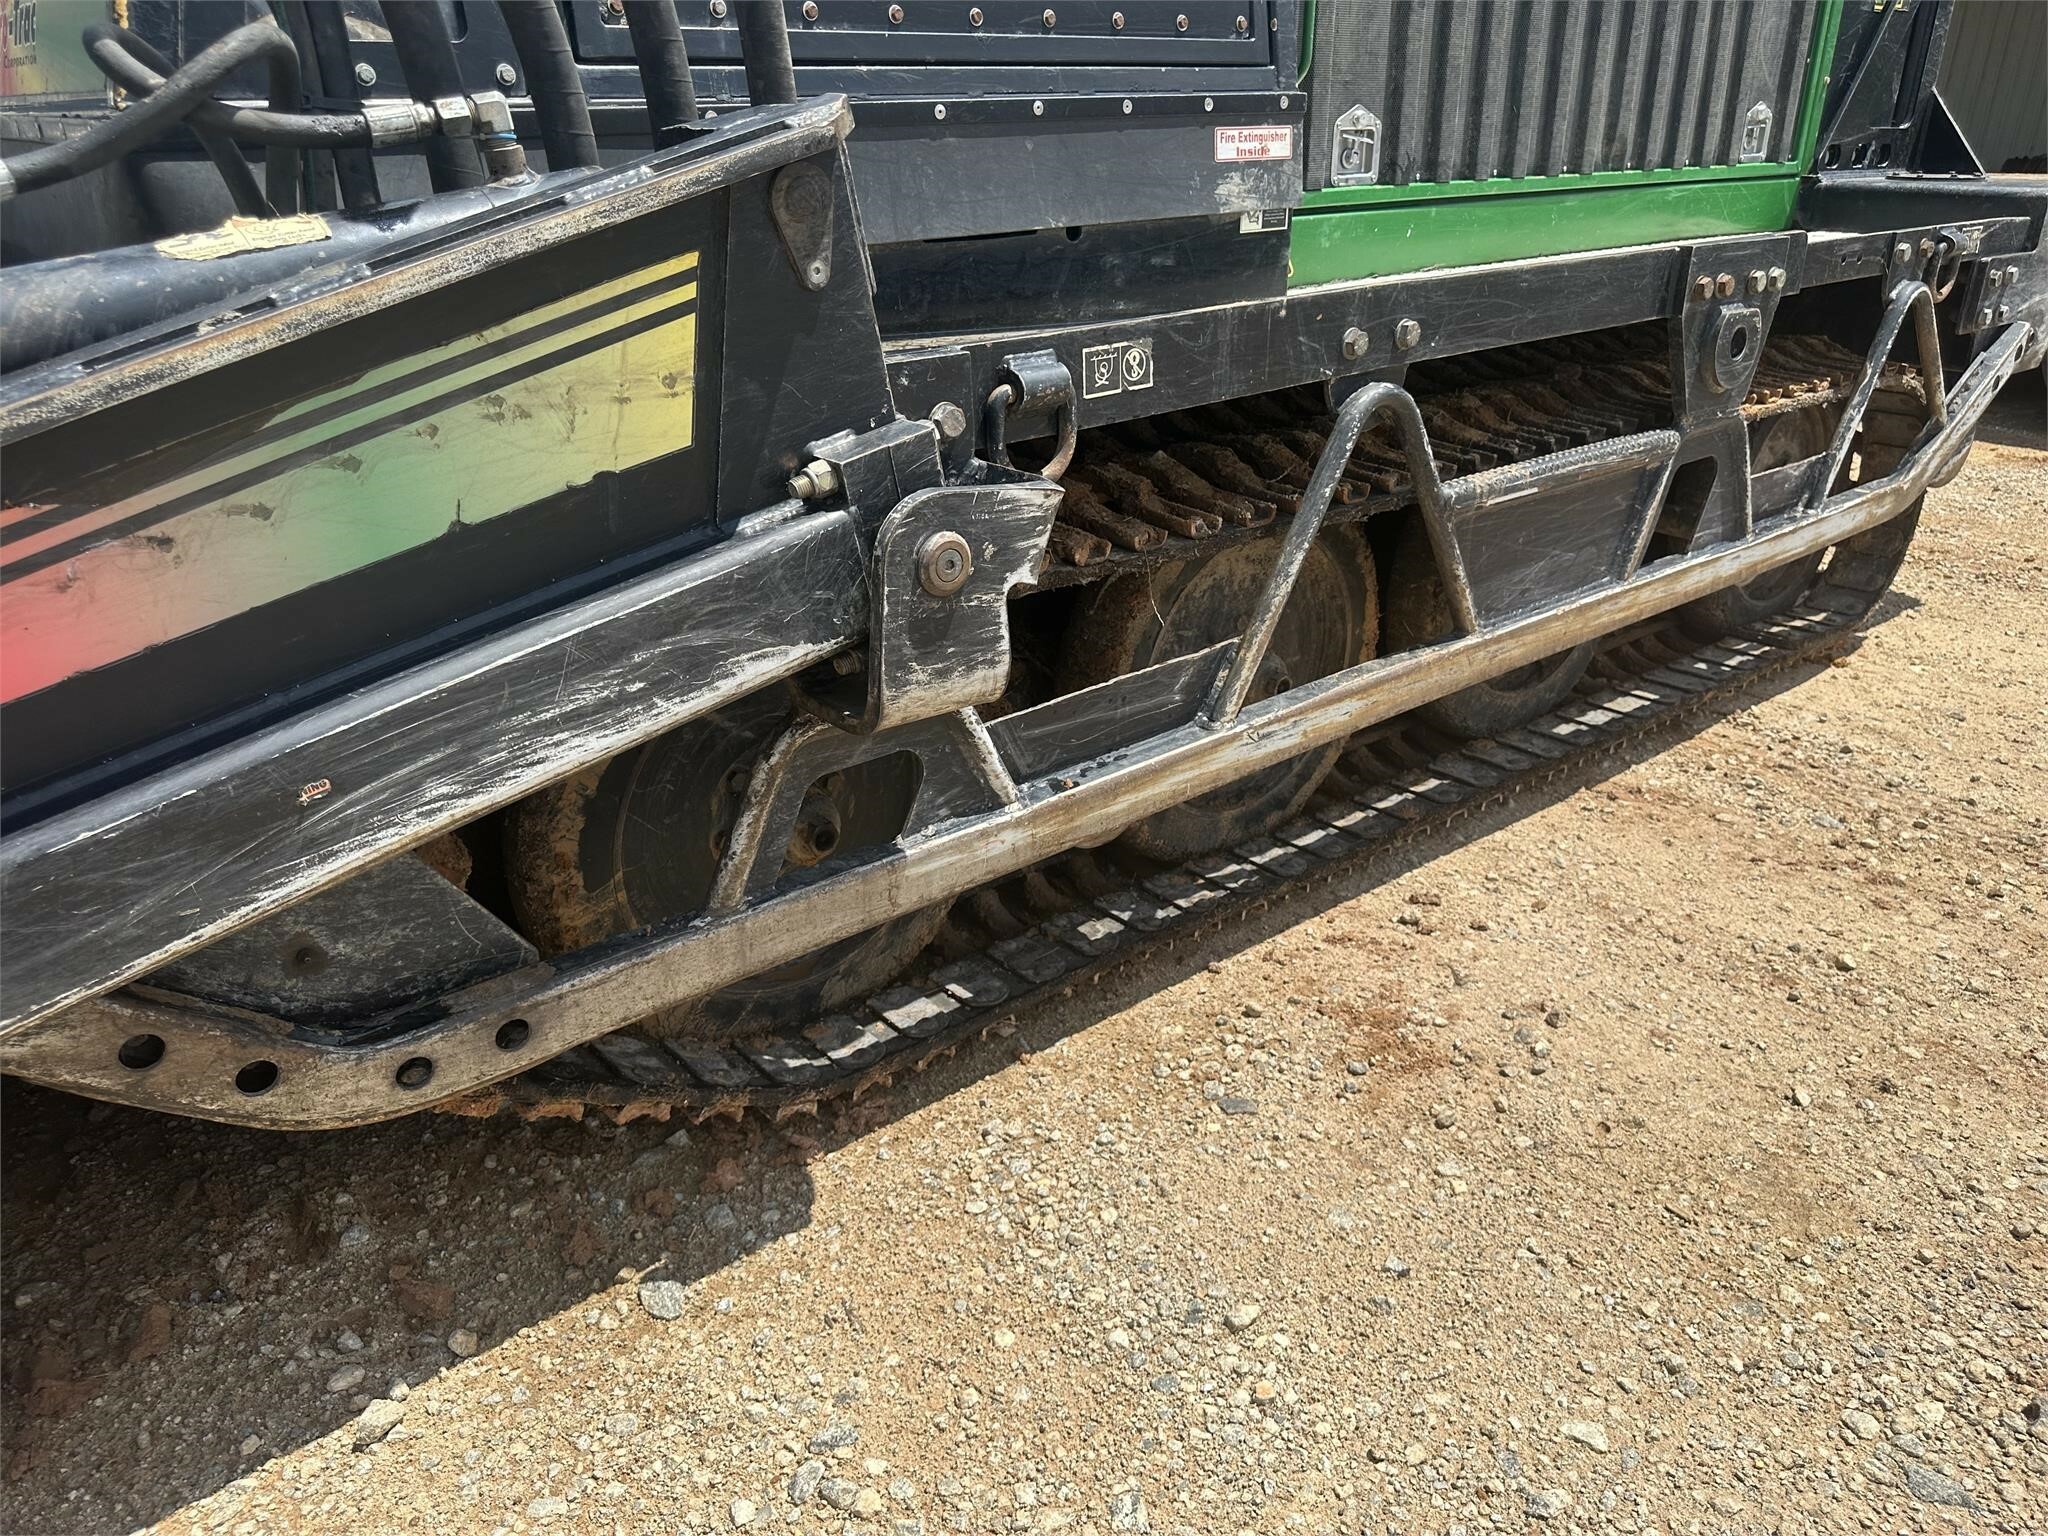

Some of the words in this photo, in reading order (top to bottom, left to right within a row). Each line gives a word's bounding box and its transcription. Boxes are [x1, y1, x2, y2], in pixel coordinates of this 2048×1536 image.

[1220, 132, 1236, 144] Fire
[1238, 131, 1288, 145] Extinguisher
[1236, 145, 1271, 157] Inside
